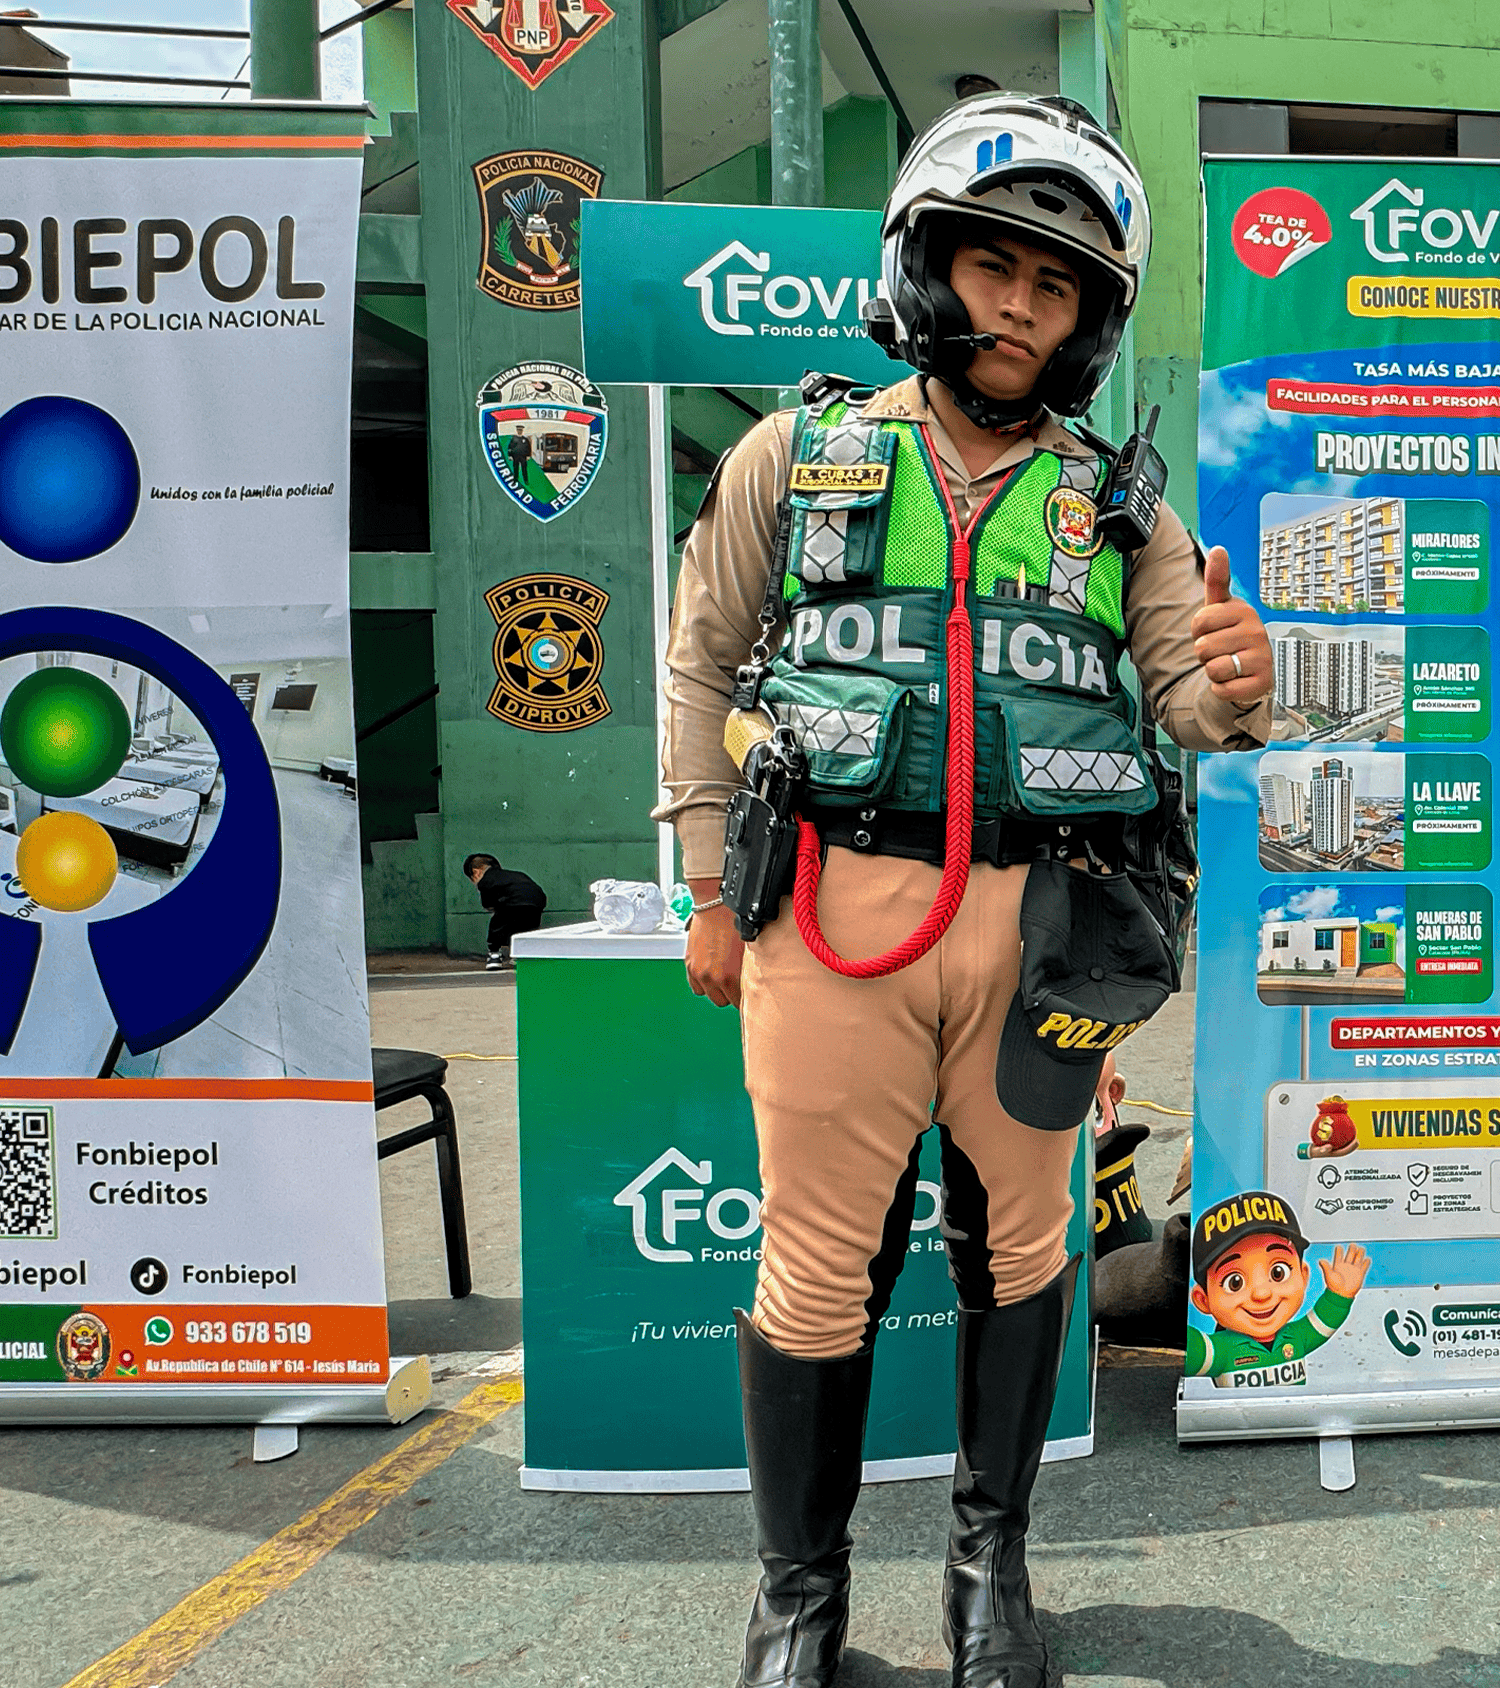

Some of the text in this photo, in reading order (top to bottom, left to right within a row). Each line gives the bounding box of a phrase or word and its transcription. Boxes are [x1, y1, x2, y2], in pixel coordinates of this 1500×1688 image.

[516, 30, 548, 45] PNP
[481, 156, 597, 188] POLICIA NACIONAL
[1258, 213, 1307, 228] TEA DE
[1243, 224, 1313, 250] 4.0%
[1415, 251, 1463, 264] Fondo
[1466, 252, 1486, 264] de
[485, 276, 581, 305] CARRETER
[1360, 284, 1429, 308] CONOCE
[34, 312, 67, 331] DE
[75, 313, 105, 331] LA
[110, 312, 203, 331] POLICIA
[209, 308, 326, 329] NACIONAL
[760, 323, 838, 338] Fondo de
[490, 367, 520, 390] POLICIA
[1353, 362, 1403, 378] TASA
[1407, 360, 1450, 378] MÁS
[1276, 387, 1368, 406] FACILIDADES
[1371, 394, 1408, 406] PARA
[1412, 396, 1429, 406] EL
[535, 409, 560, 419] 1981
[1317, 431, 1471, 473] PROYECTOS
[486, 432, 534, 505] SEGURIDAD
[550, 432, 602, 511] FERROVIARIA
[801, 469, 813, 479] R.
[818, 469, 864, 479] CUBAS
[150, 483, 335, 501] Unidos con la familia policial
[1411, 532, 1481, 549] MIRAFLORES
[1415, 569, 1476, 578] PRÓXIMAMENTE
[499, 584, 597, 610] POLICIA
[1412, 662, 1480, 682] LAZARETO
[503, 699, 597, 723] DIPROVE
[1416, 701, 1477, 709] PRÓXIMAMENTE
[1412, 781, 1481, 802] LA LLAVE
[1416, 822, 1478, 830] PRÓXIMAMENTE
[1416, 910, 1483, 925] PALMERAS DE
[1416, 924, 1483, 942] SAN PABLO
[1338, 1026, 1487, 1041] DEPARTAMENTOS
[1490, 1026, 1500, 1039] Y
[1354, 1054, 1377, 1067] EN
[1381, 1053, 1440, 1067] ZONAS
[1371, 1109, 1483, 1139] VIVIENDAS
[76, 1142, 219, 1172] Fonbiepol
[89, 1181, 208, 1205] Créditos
[1204, 1197, 1288, 1242] POLICIA
[182, 1265, 297, 1289] Fonbiepol
[185, 1321, 311, 1344] 933 678 519
[1432, 1329, 1458, 1345] (01)
[221, 1359, 236, 1373] de
[237, 1358, 268, 1373] Chile
[284, 1359, 305, 1373] 614
[313, 1358, 346, 1373] Jesús
[347, 1358, 380, 1373] María
[1233, 1360, 1306, 1388] POLICIA
